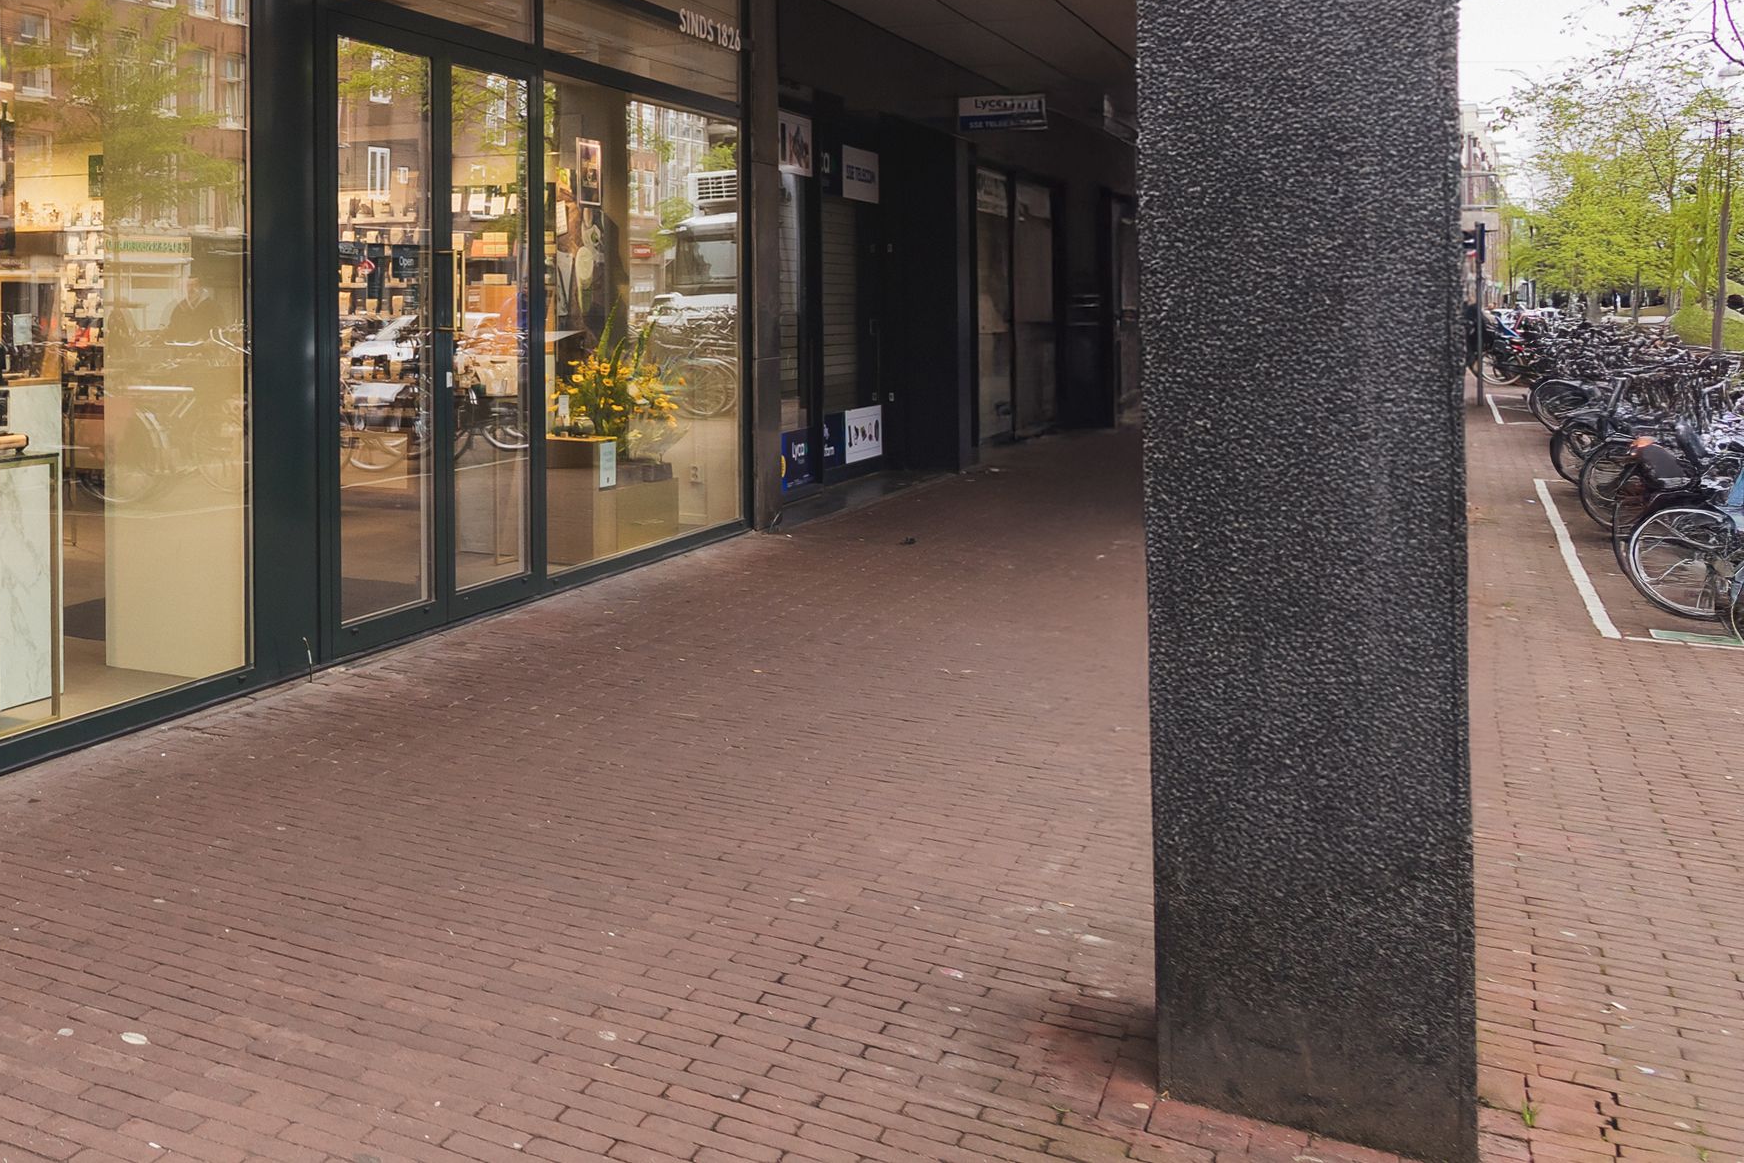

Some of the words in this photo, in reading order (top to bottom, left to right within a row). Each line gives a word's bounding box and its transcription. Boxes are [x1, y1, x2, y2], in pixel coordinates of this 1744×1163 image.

[679, 7, 714, 42] SINDS
[716, 23, 742, 52] 1826
[398, 255, 415, 268] Open
